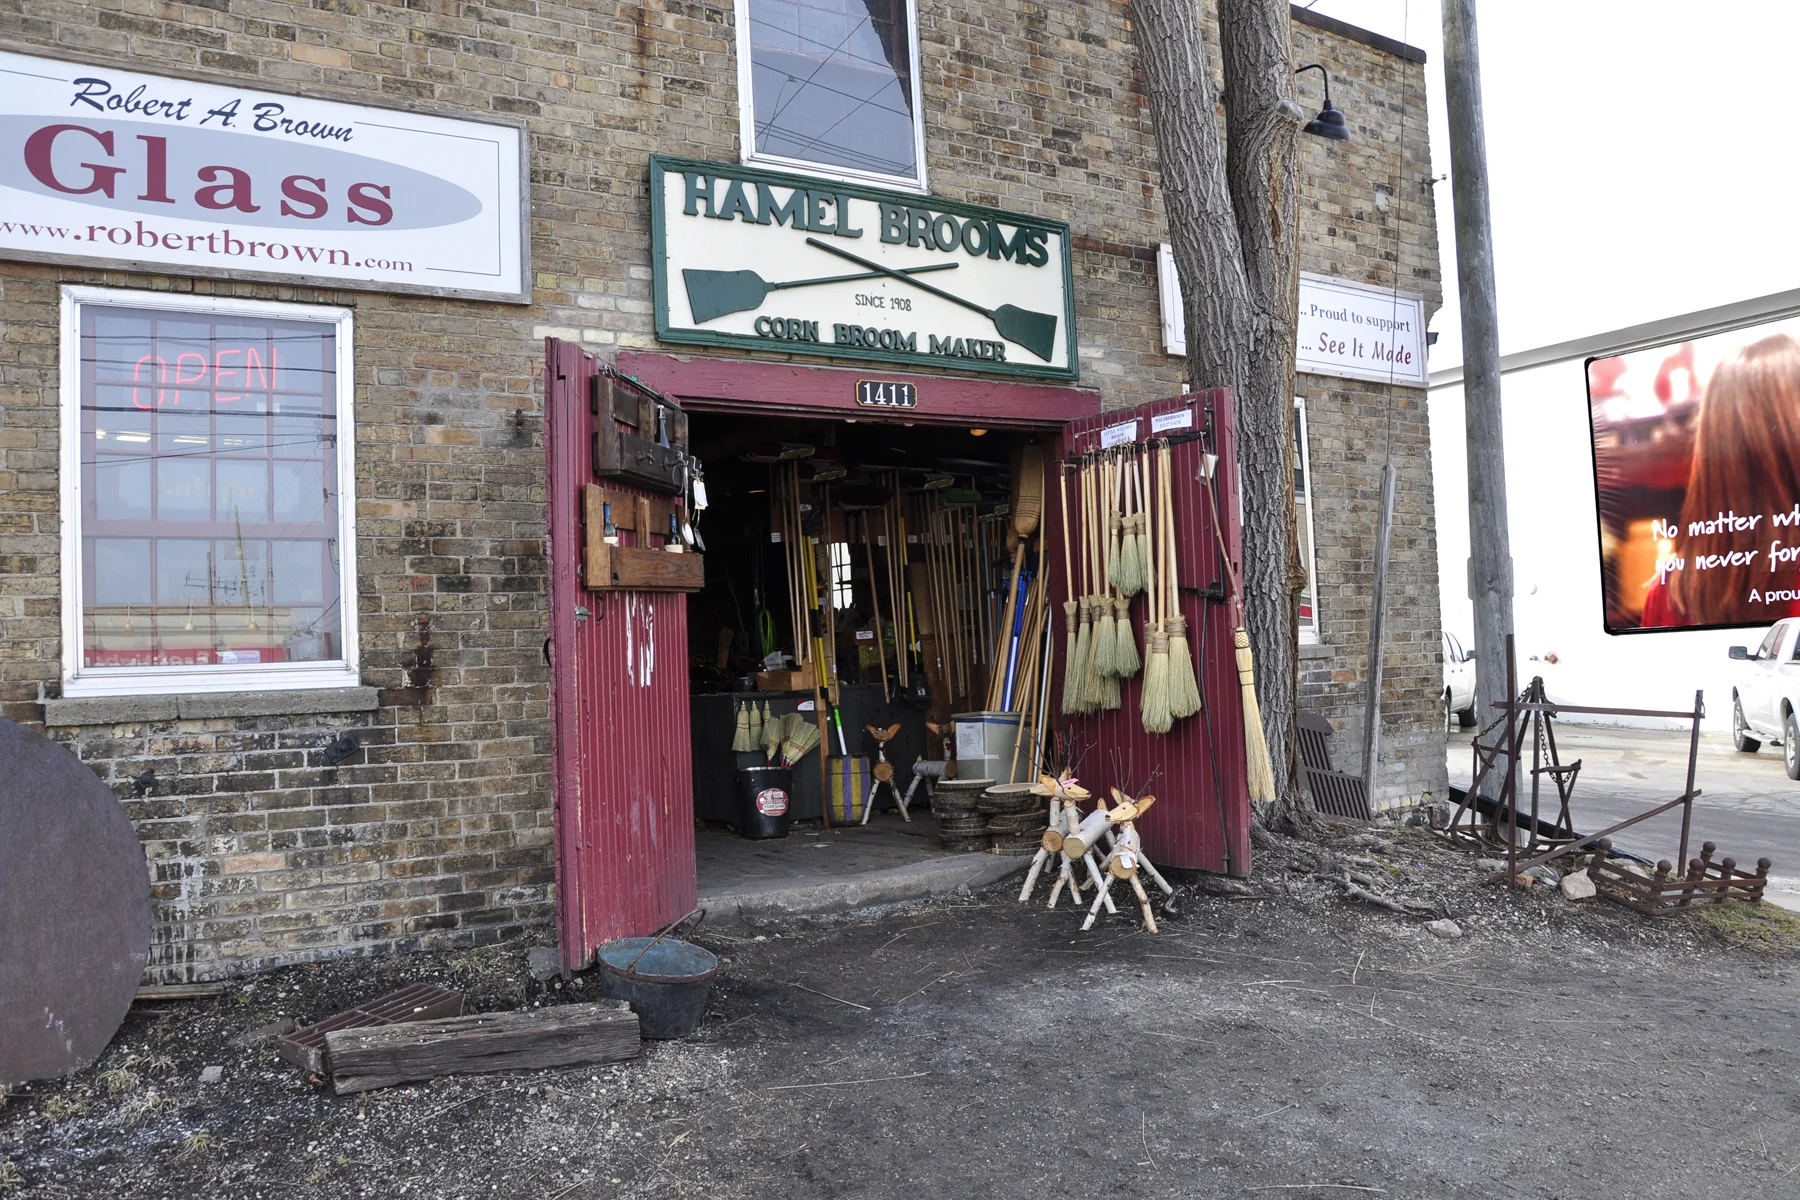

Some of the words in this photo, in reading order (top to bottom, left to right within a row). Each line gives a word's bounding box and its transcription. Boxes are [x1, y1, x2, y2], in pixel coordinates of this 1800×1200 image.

[70, 77, 193, 121] Robert
[253, 103, 354, 143] Brown
[24, 124, 394, 226] Glass
[683, 172, 864, 239] HAMEL
[879, 202, 1049, 267] BROOMS
[855, 294, 886, 310] SINCE
[889, 297, 912, 312] 1908
[1309, 303, 1347, 322] Proud
[1351, 312, 1363, 324] to
[1366, 315, 1411, 332] support
[754, 316, 820, 342] CORN
[834, 323, 917, 352] BROOM
[929, 334, 1007, 361] MAKER
[1318, 332, 1346, 355] See
[1352, 338, 1364, 358] It
[1371, 341, 1412, 365] Made
[133, 348, 277, 410] OPEN
[862, 382, 911, 407] 1411
[1652, 518, 1678, 541] No
[1688, 510, 1763, 537] matter
[1655, 557, 1685, 585] you
[1695, 550, 1758, 570] never
[1748, 588, 1762, 603] A
